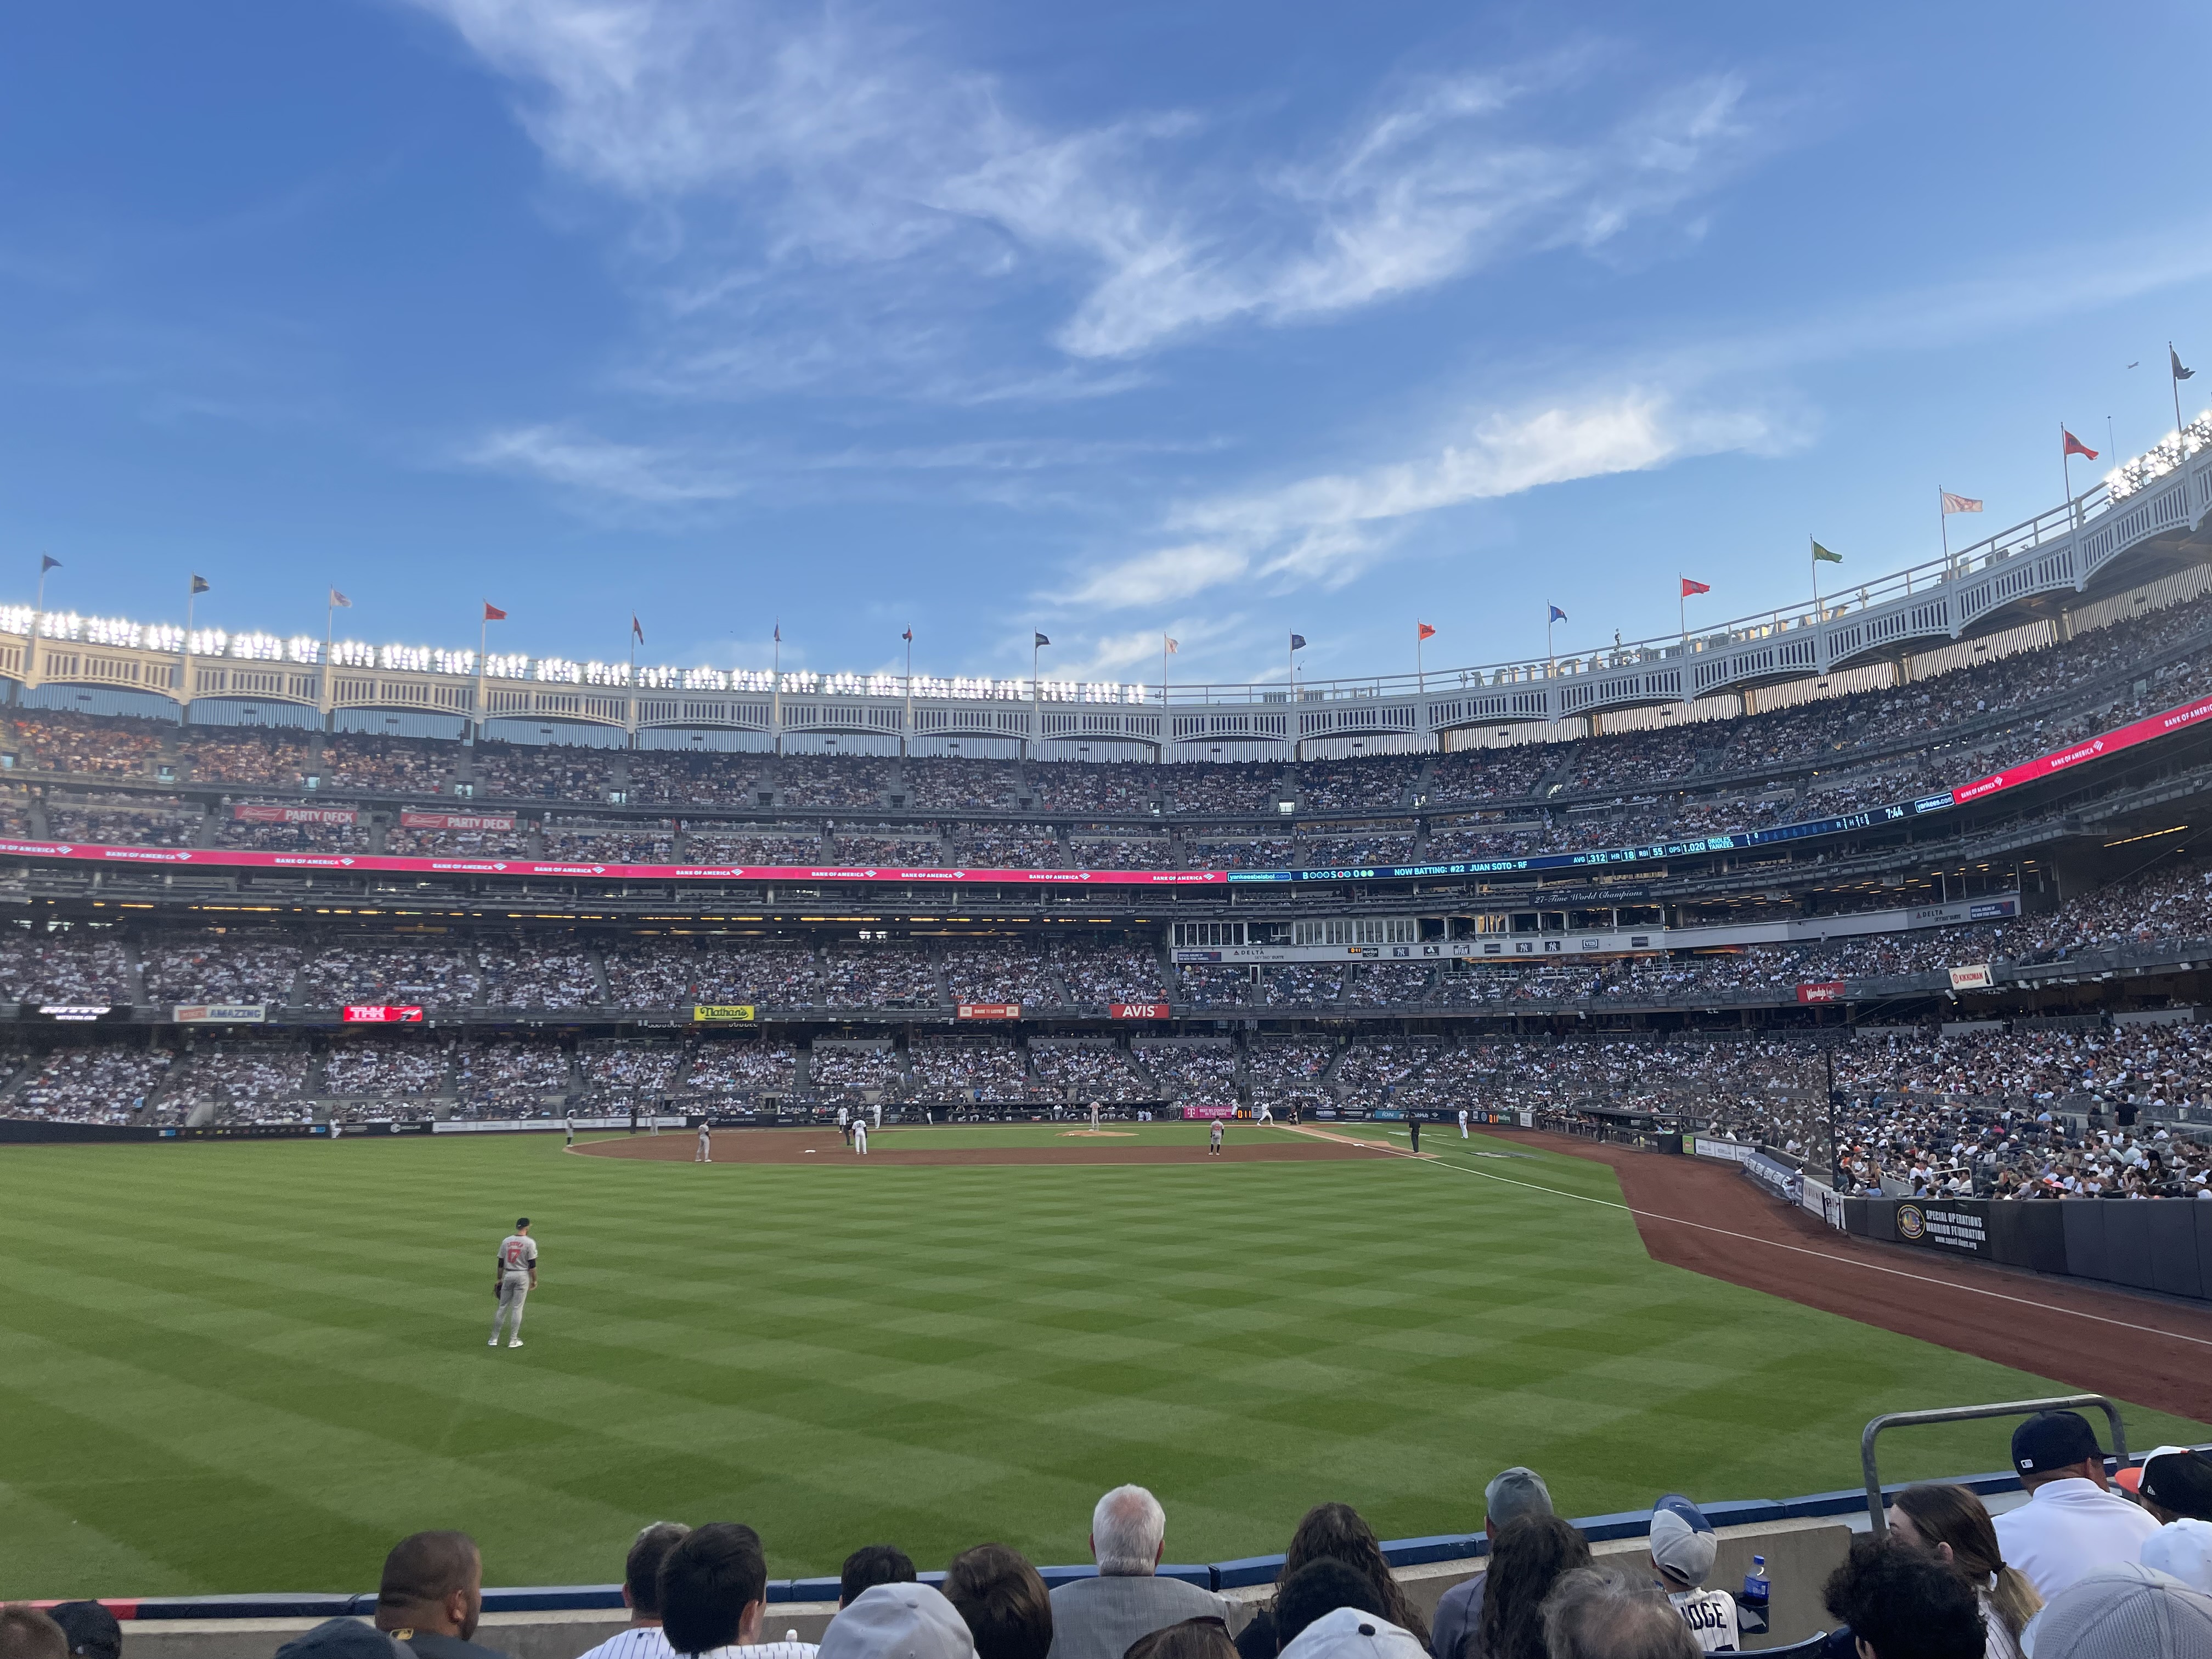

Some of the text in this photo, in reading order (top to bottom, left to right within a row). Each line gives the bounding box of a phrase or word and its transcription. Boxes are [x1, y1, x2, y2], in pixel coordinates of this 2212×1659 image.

[2164, 704, 2212, 727] BANK OF AMERIC
[2051, 747, 2094, 767] BANK OF AMERICA
[1917, 797, 1952, 811] yankees.com
[285, 810, 321, 822] PARTY
[323, 811, 353, 823] DECK
[1885, 805, 1904, 819] 7:44
[448, 817, 482, 828] PARTY
[483, 819, 511, 830] DECK
[1802, 826, 1807, 835] 7
[1707, 836, 1731, 844] ORIOLES
[1708, 842, 1734, 850] YANKEES
[1589, 854, 1606, 862] .312
[1624, 851, 1635, 860] 18
[1652, 848, 1663, 856] 55
[1683, 842, 1705, 853] 1.020
[1394, 868, 1413, 876] NOW
[1414, 866, 1447, 875] BATTING:
[1469, 864, 1490, 872] JUAN
[1492, 862, 1511, 870] SOTO
[1534, 890, 1643, 904] 27-Time World Champions
[1959, 972, 1983, 981] KIKKOMAN
[1806, 986, 1826, 1001] Wendy's
[211, 1009, 262, 1018] AMAZING
[349, 1007, 385, 1018] THK
[700, 1007, 748, 1017] Nathan's
[1122, 1005, 1155, 1017] AVIS
[1187, 1108, 1195, 1118] T
[1926, 1209, 1948, 1222] SPECIAL
[1948, 1212, 1982, 1228] OPERATIONS
[1926, 1222, 1950, 1235] WARRIOR
[1951, 1226, 1985, 1241] FOUNDATION
[508, 1249, 521, 1264] 17
